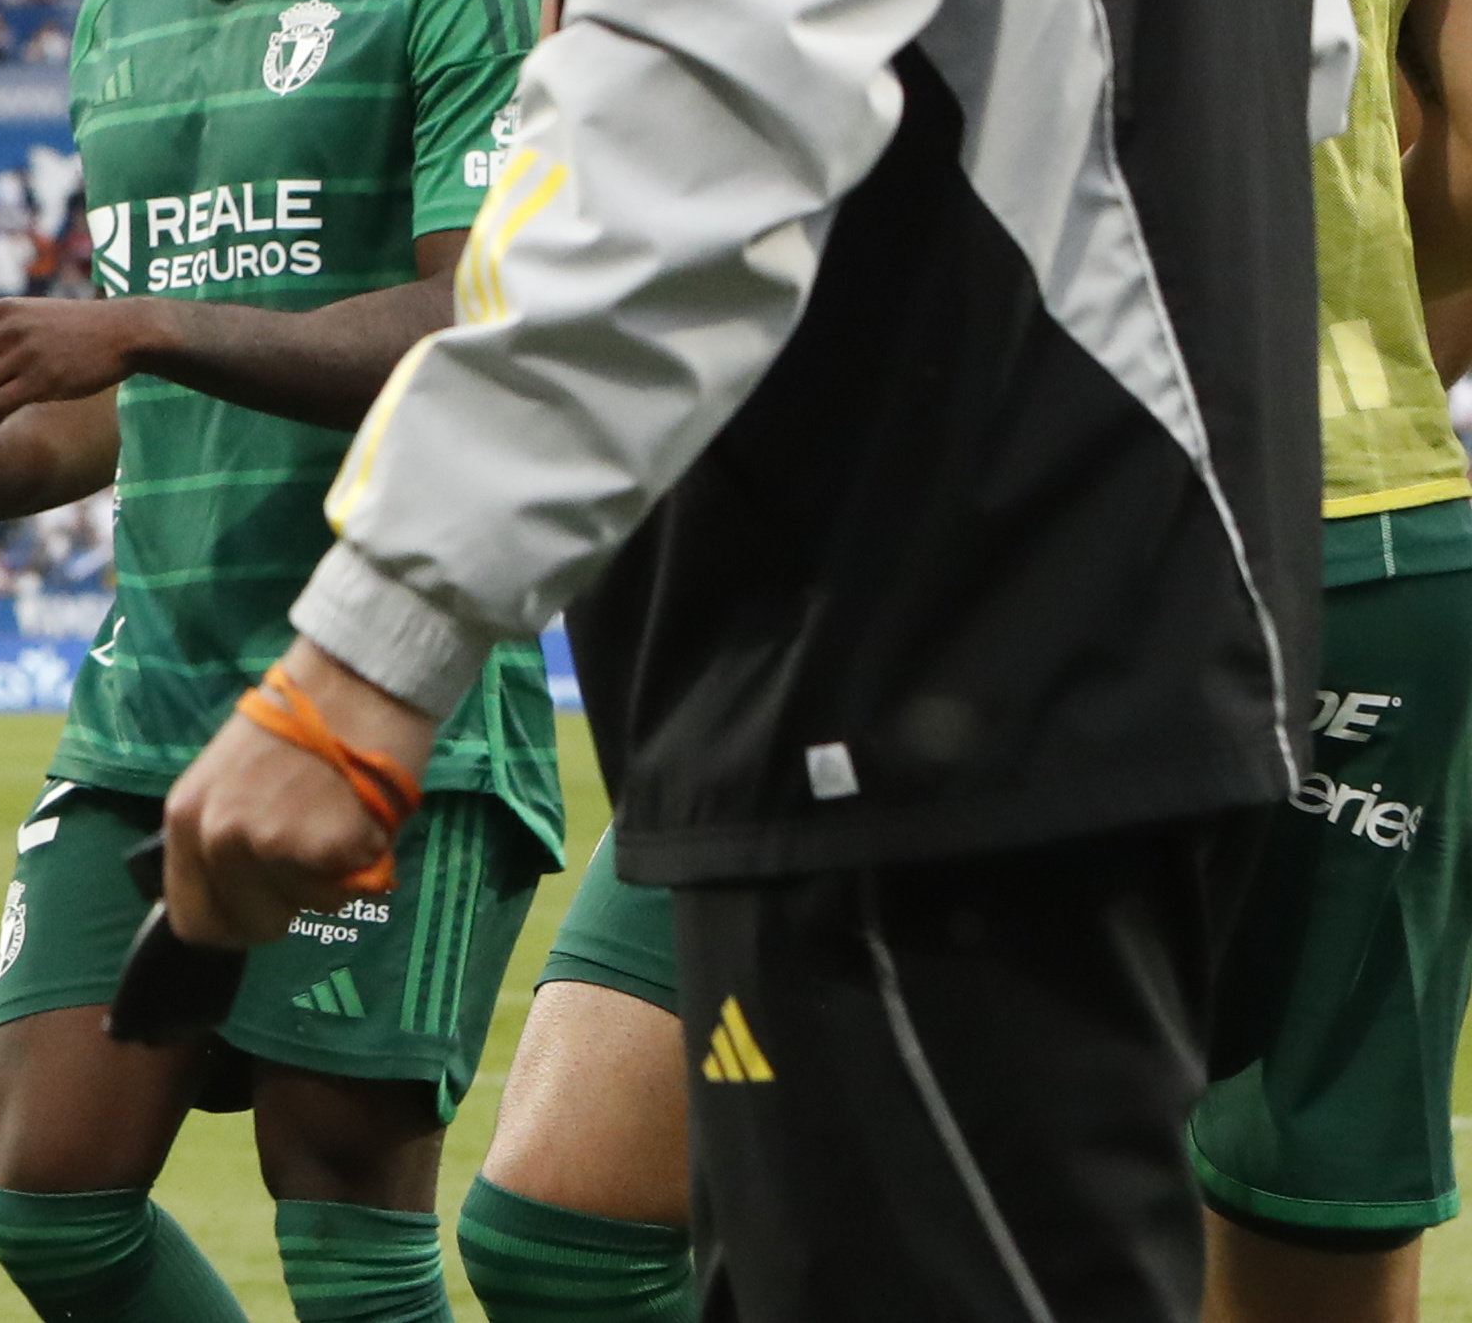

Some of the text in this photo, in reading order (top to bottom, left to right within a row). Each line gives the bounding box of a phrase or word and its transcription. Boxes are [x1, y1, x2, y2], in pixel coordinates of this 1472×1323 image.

[147, 180, 322, 247] REALE
[147, 240, 322, 292] SEGUROS
[287, 915, 359, 945] Burgos
